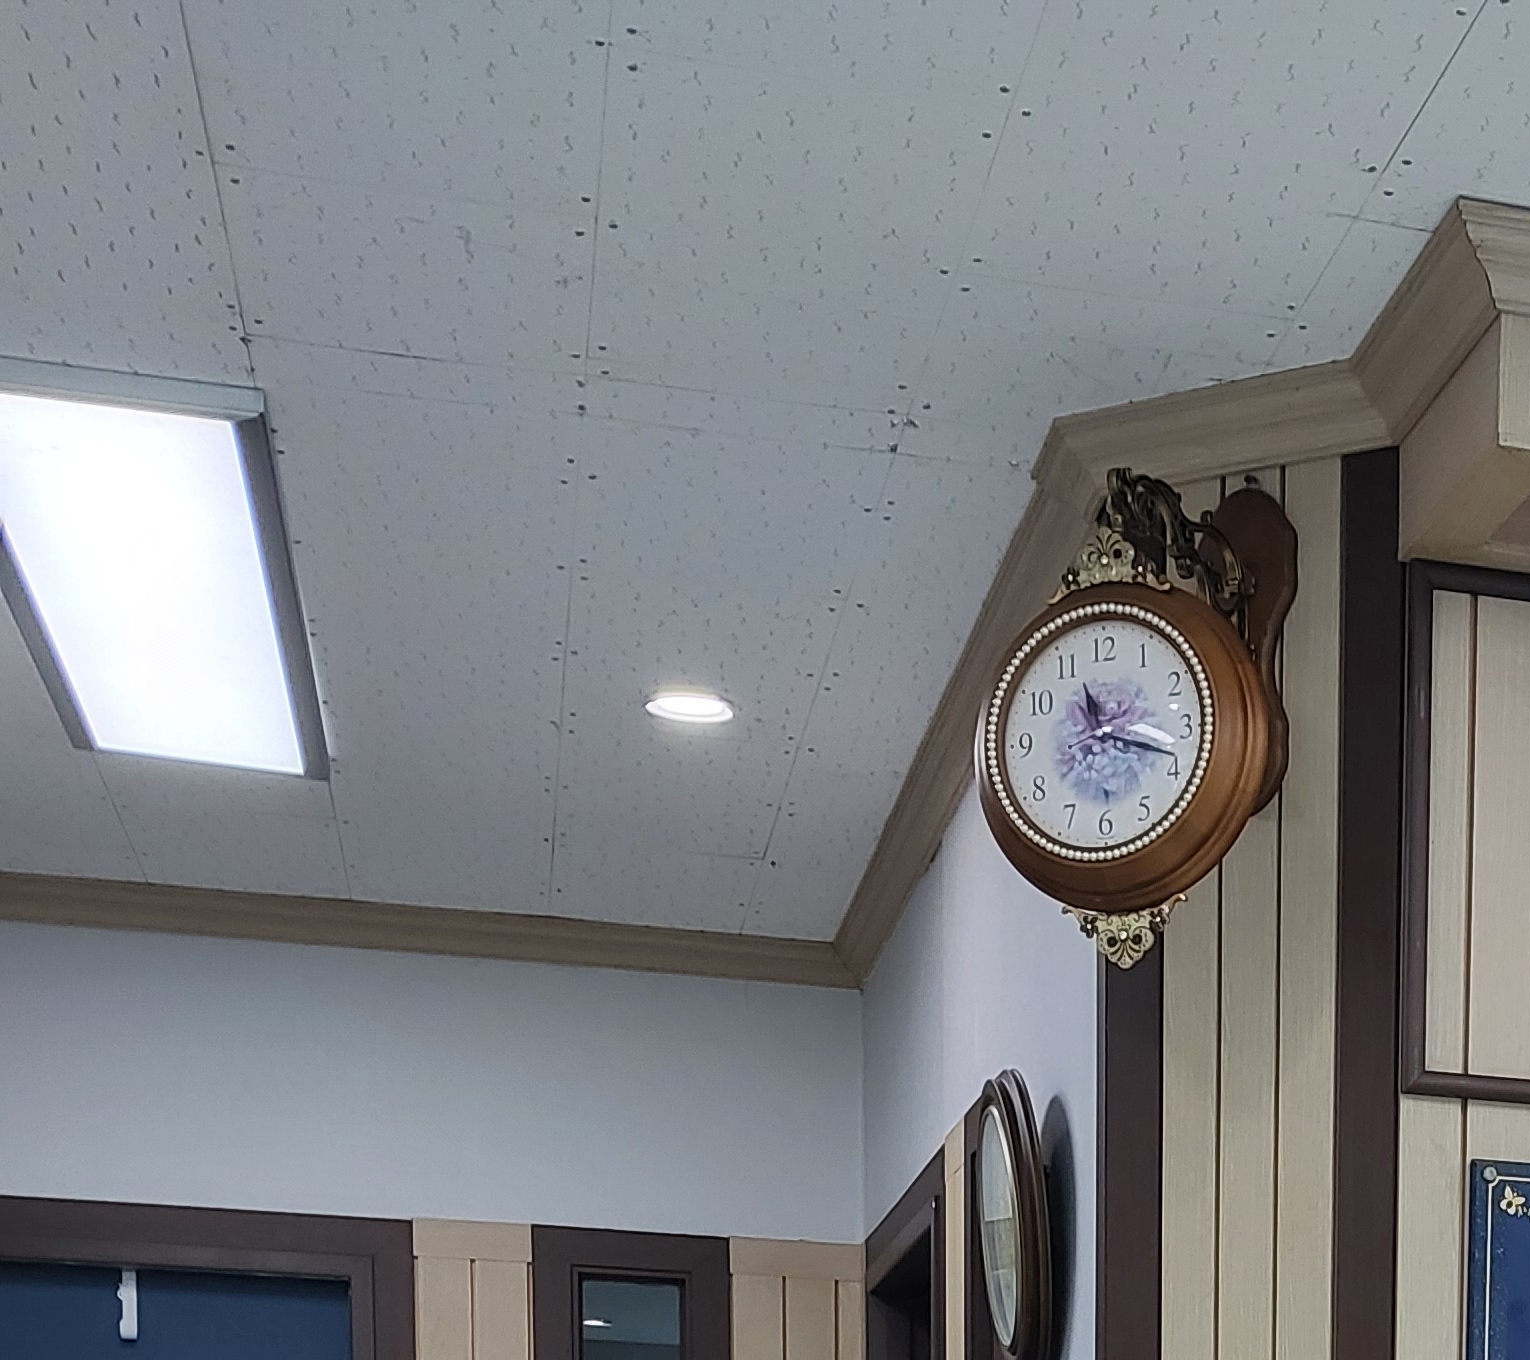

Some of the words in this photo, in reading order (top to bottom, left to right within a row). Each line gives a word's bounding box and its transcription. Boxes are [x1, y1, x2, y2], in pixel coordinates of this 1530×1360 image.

[1092, 636, 1117, 663] 12
[1139, 643, 1148, 668] 1
[1057, 653, 1077, 680] 11
[1168, 671, 1182, 697] 2
[1030, 689, 1053, 716] 10
[1180, 713, 1193, 740] 3
[1018, 732, 1033, 759] 9
[1167, 755, 1181, 781] 4
[1032, 775, 1047, 802] 8
[1063, 804, 1077, 830] 7
[1099, 809, 1113, 836] 6
[1138, 796, 1151, 822] 5
